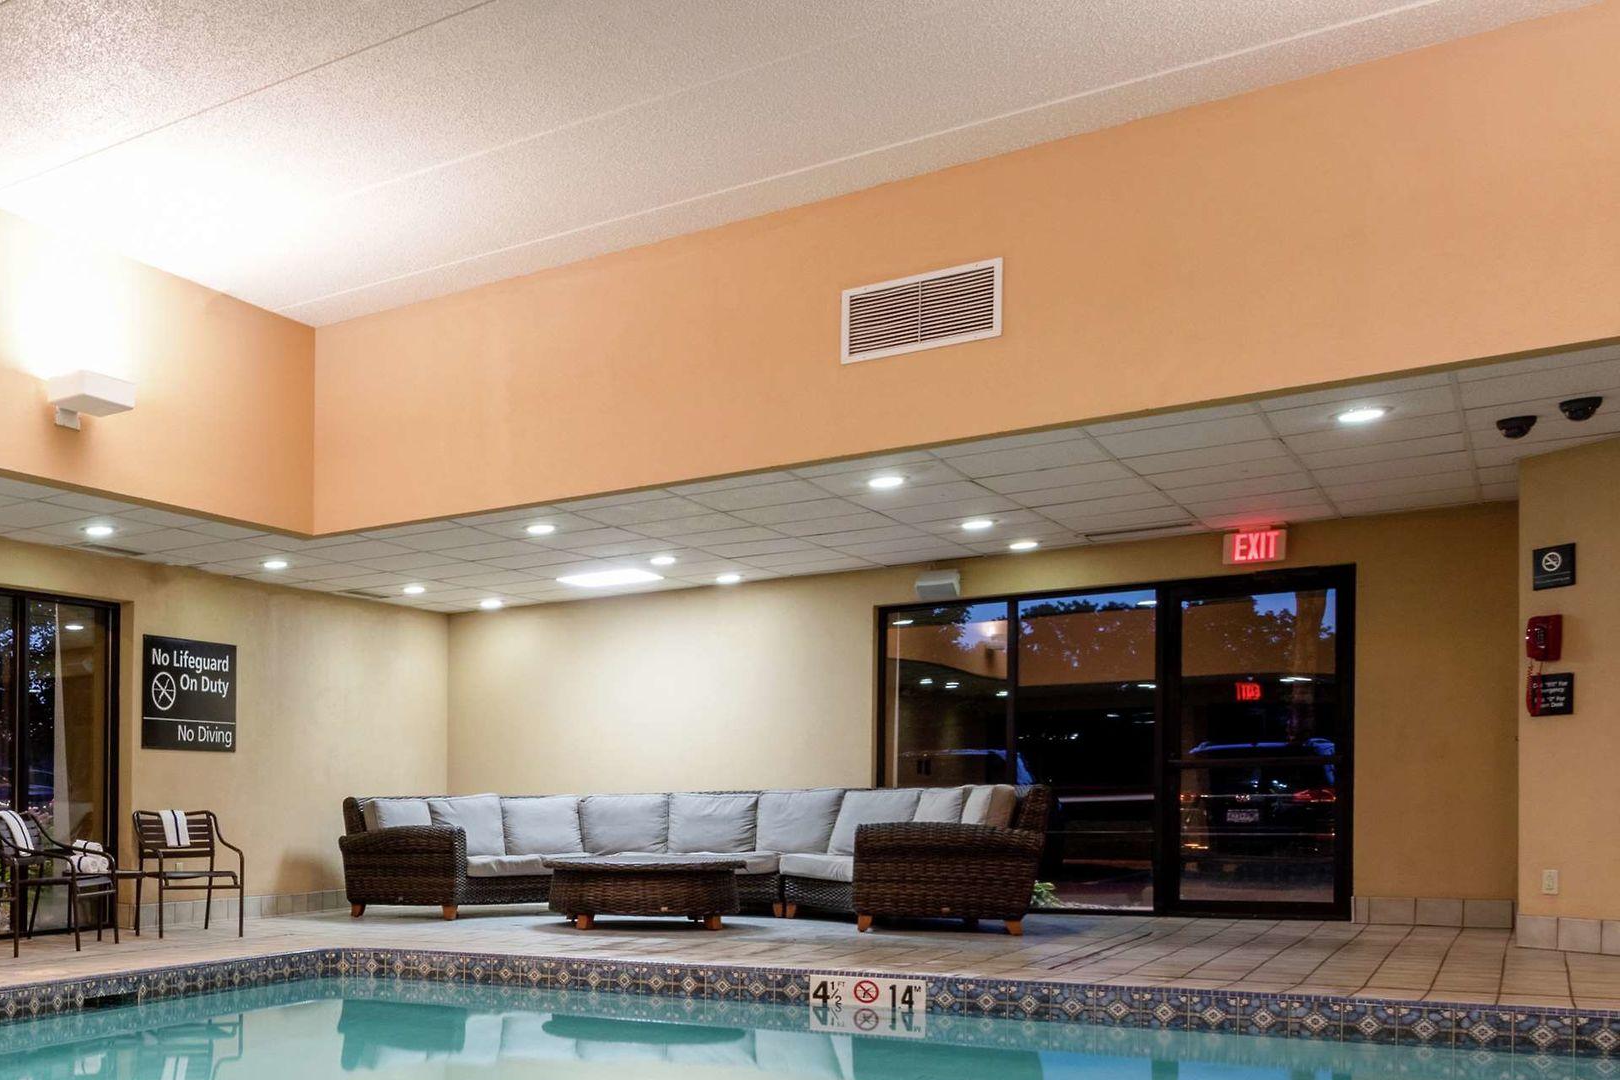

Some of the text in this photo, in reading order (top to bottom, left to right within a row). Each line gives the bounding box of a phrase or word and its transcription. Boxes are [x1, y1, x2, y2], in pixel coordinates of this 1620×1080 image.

[1233, 531, 1280, 561] EXIT
[151, 647, 229, 674] No Lifeguard
[180, 673, 230, 698] On Duty
[177, 724, 232, 748] No Diving
